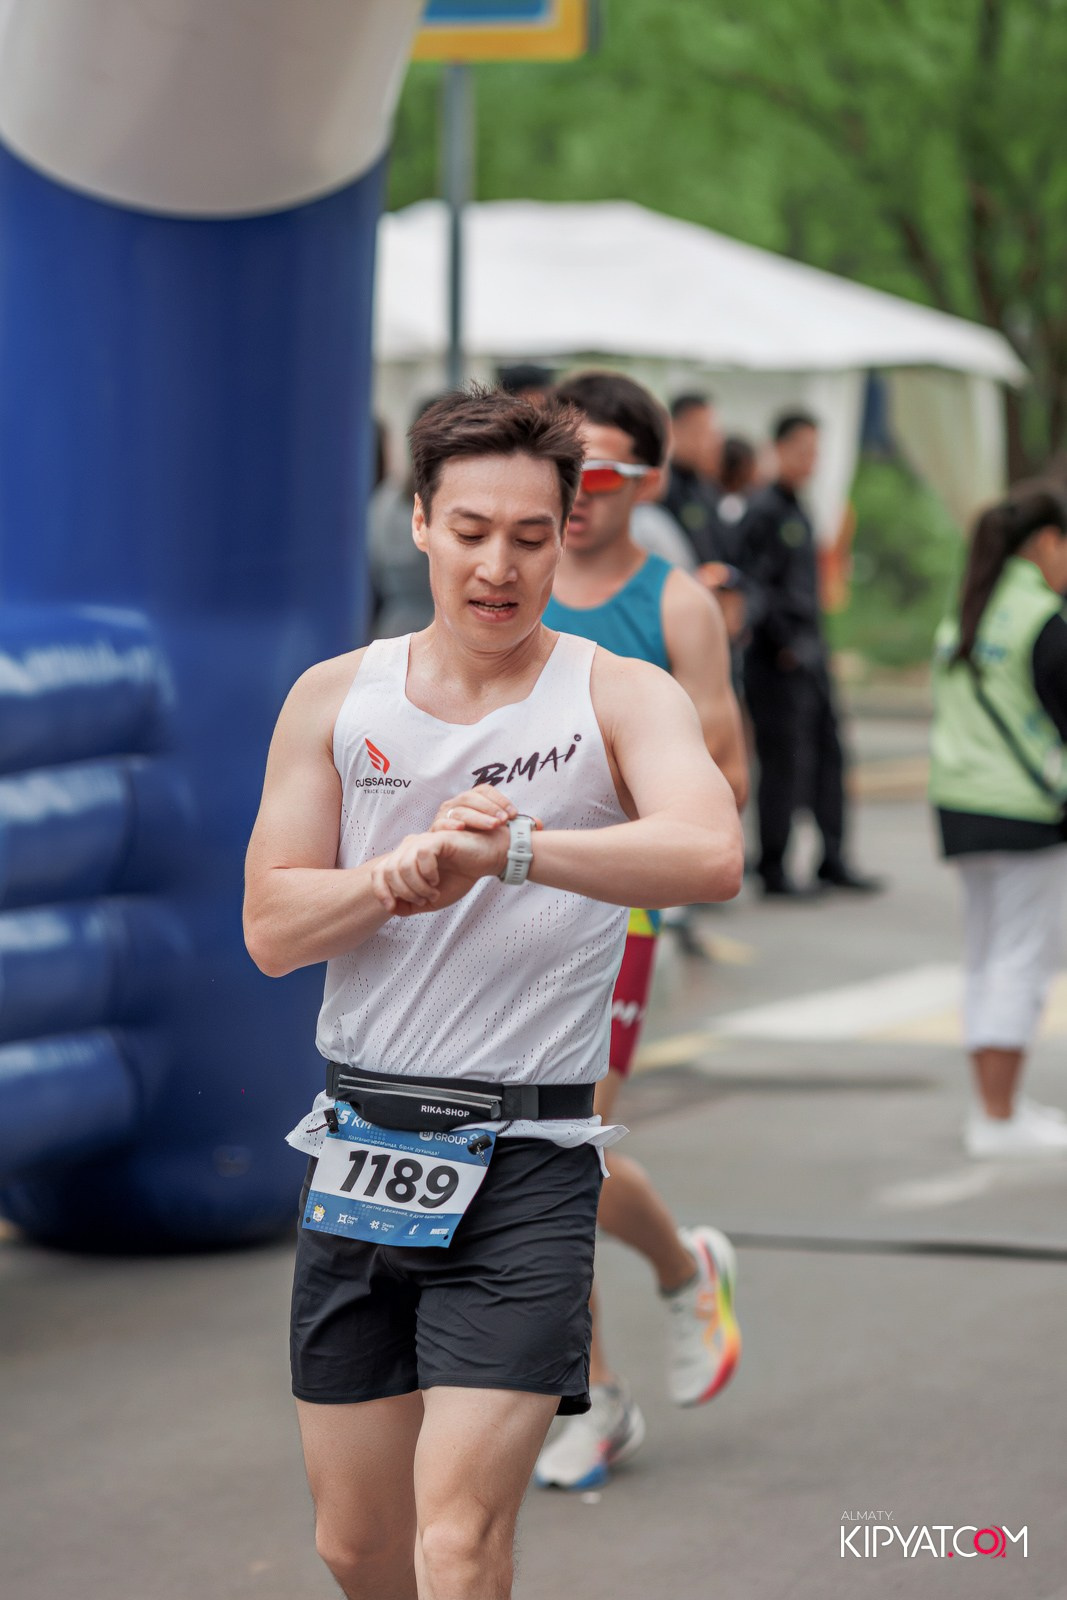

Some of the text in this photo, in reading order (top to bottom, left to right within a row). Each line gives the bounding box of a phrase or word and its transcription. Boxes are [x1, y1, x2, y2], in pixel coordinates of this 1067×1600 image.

[355, 777, 412, 788] GUSSAROV
[337, 1109, 352, 1125] 5
[420, 1104, 470, 1118] RIKA-SHOP
[434, 1132, 468, 1146] GROUP
[339, 1149, 460, 1209] 1189
